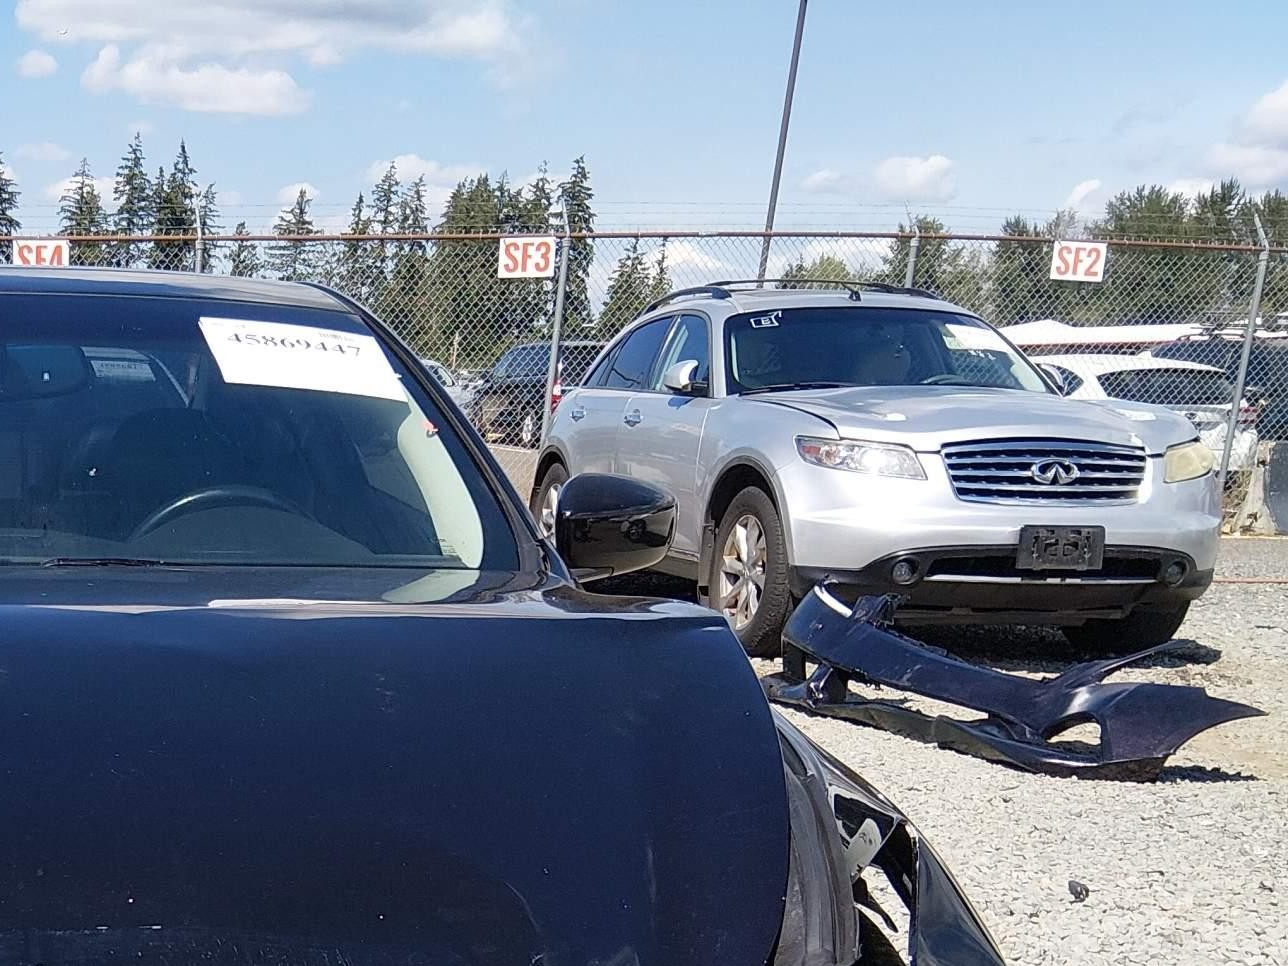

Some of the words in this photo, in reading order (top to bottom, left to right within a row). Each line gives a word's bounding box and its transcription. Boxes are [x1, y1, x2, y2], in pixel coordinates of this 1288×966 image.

[504, 241, 551, 273] SF3
[1055, 245, 1101, 277] SF2
[226, 332, 361, 357] 45869447
